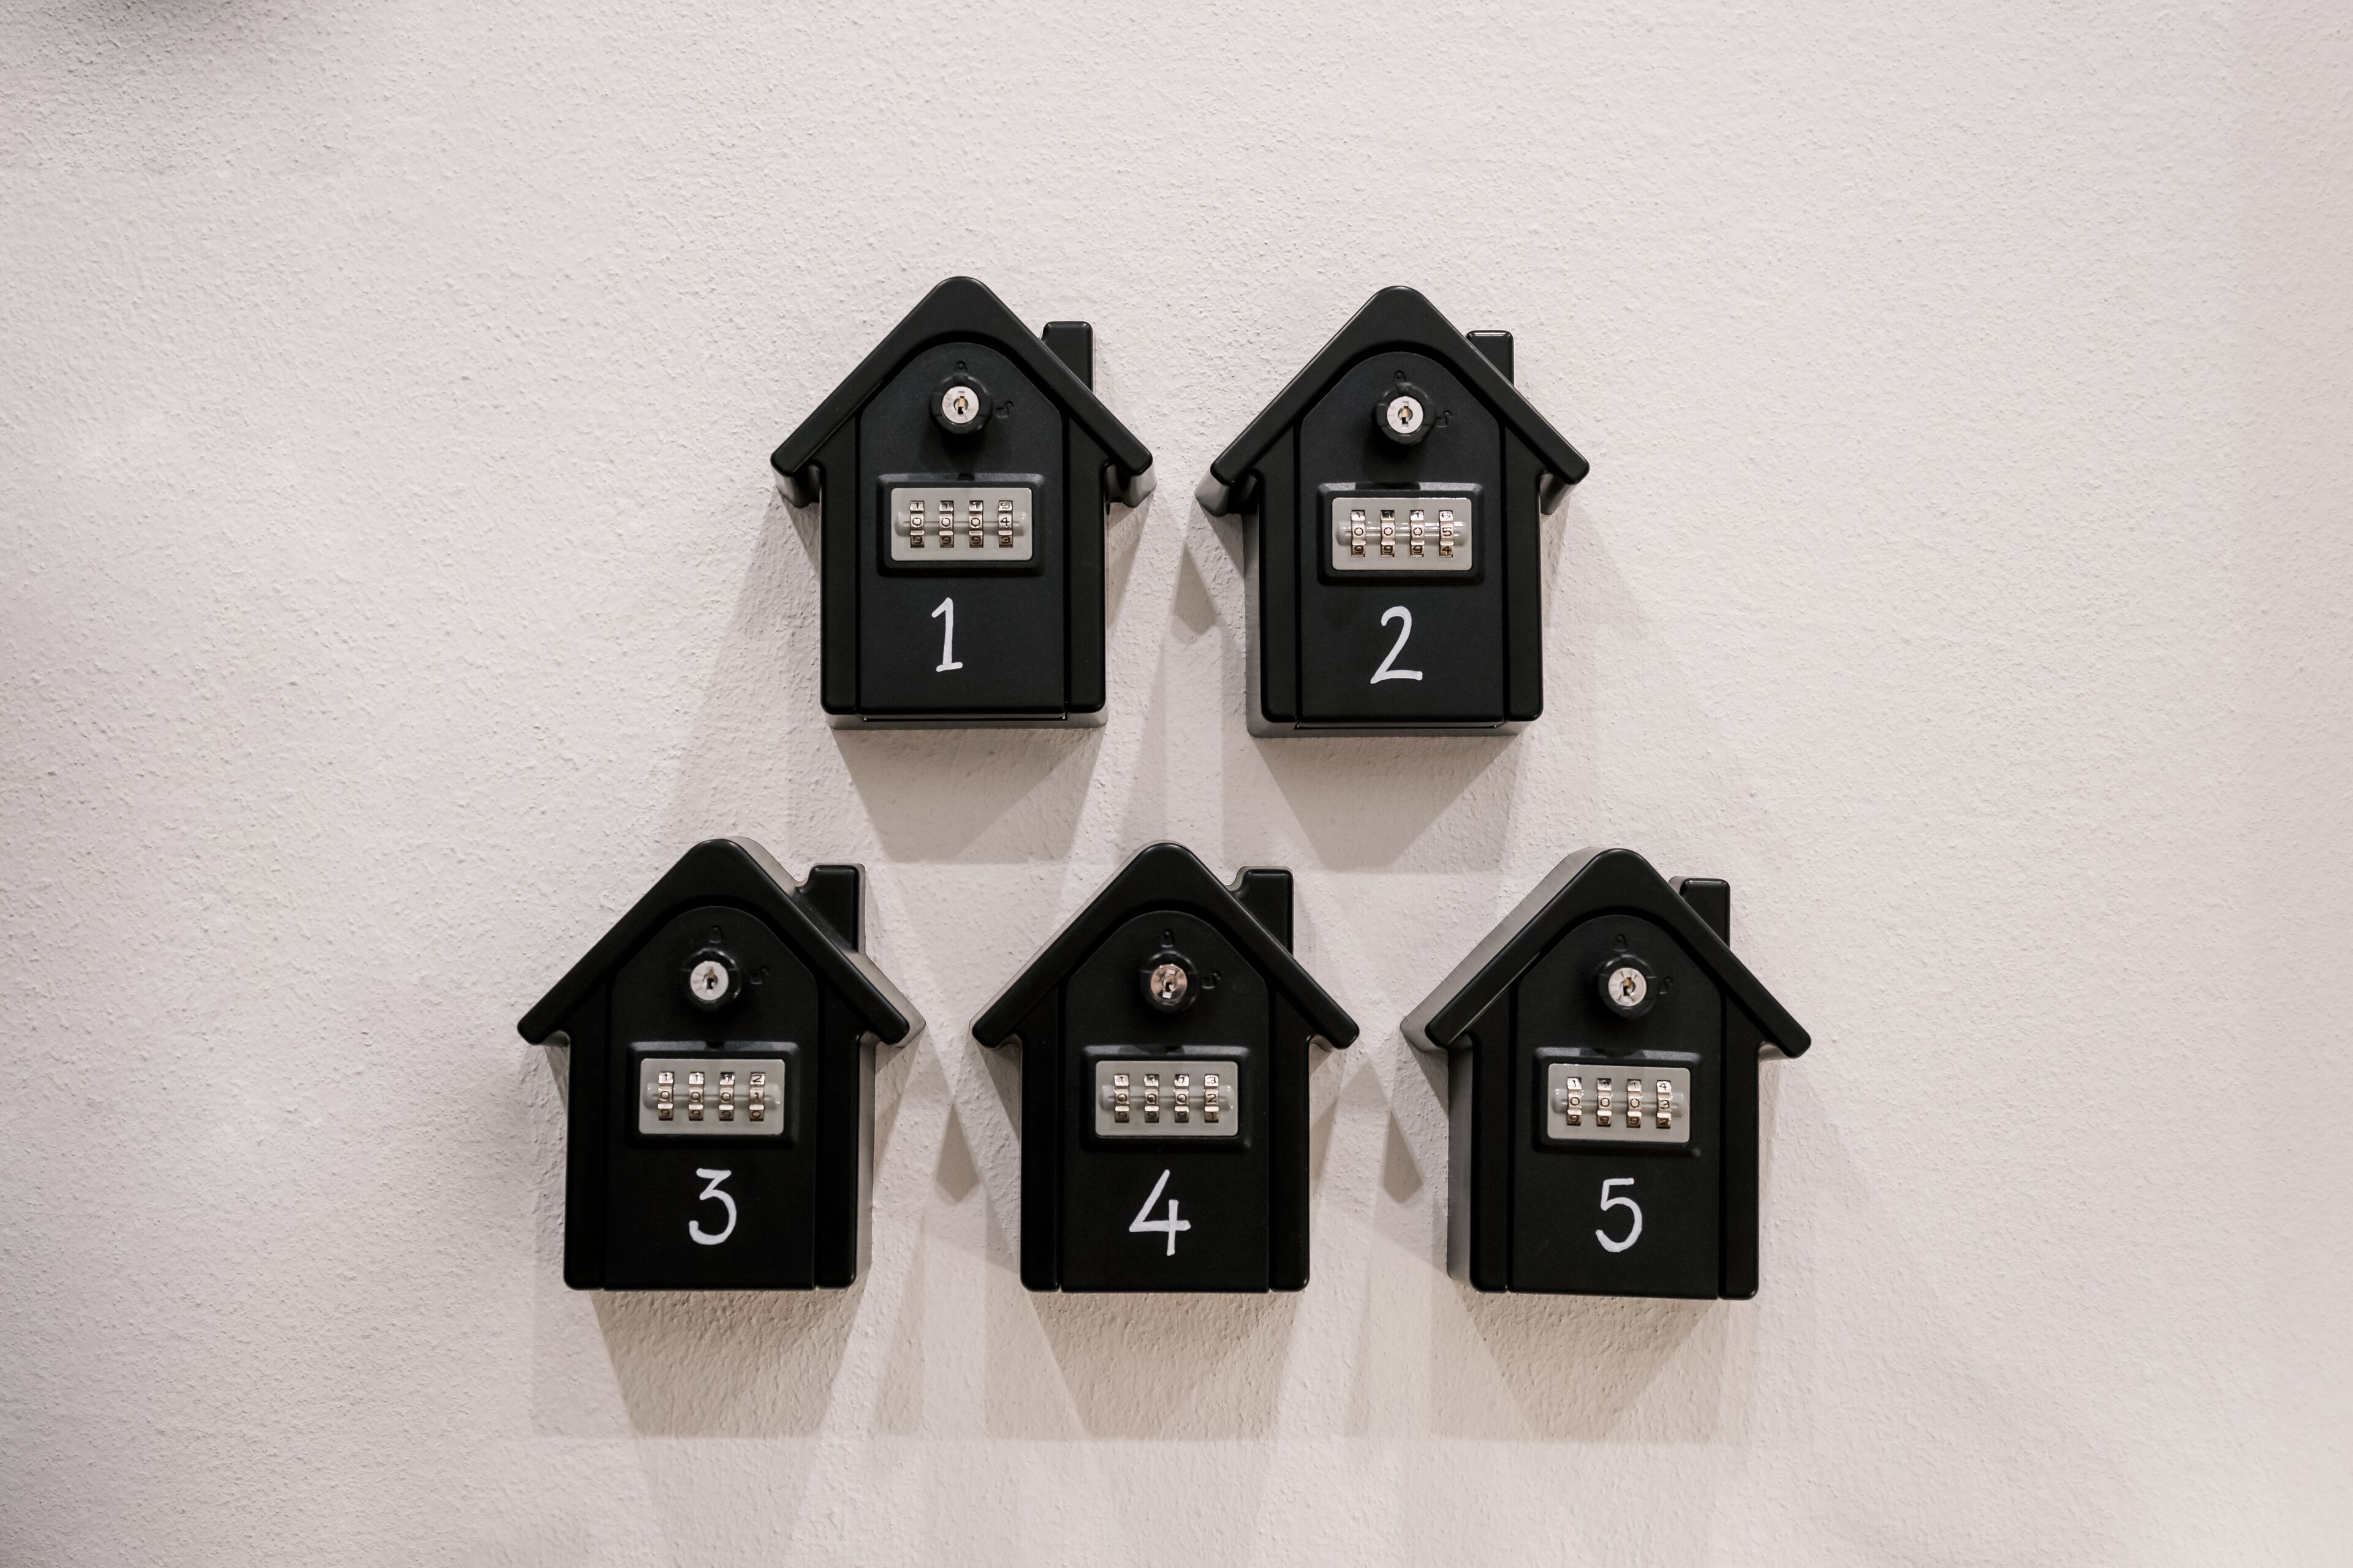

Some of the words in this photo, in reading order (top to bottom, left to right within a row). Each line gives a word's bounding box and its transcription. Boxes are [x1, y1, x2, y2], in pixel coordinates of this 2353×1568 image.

[912, 517, 922, 526] 0
[941, 517, 950, 526] 0
[971, 517, 980, 527] 0
[1001, 517, 1010, 526] 4
[1354, 527, 1363, 536] 0
[1384, 527, 1393, 536] 0
[1413, 527, 1422, 536] 0
[1442, 527, 1452, 537] 5
[1354, 545, 1363, 554] 9
[1384, 545, 1393, 553] 9
[1413, 545, 1422, 553] 9
[1442, 546, 1452, 555] 4
[931, 597, 963, 672] 1
[1370, 605, 1423, 684] 2
[660, 1091, 670, 1100] 0
[691, 1091, 701, 1100] 0
[721, 1092, 731, 1102] 0
[1177, 1094, 1187, 1102] 0
[1207, 1094, 1216, 1102] 2
[1570, 1097, 1580, 1105] 0
[1600, 1097, 1610, 1107] 0
[1630, 1099, 1640, 1108] 0
[1660, 1100, 1670, 1108] 3
[689, 1168, 737, 1245] 3
[1129, 1169, 1191, 1256] 4
[1595, 1178, 1643, 1252] 5
